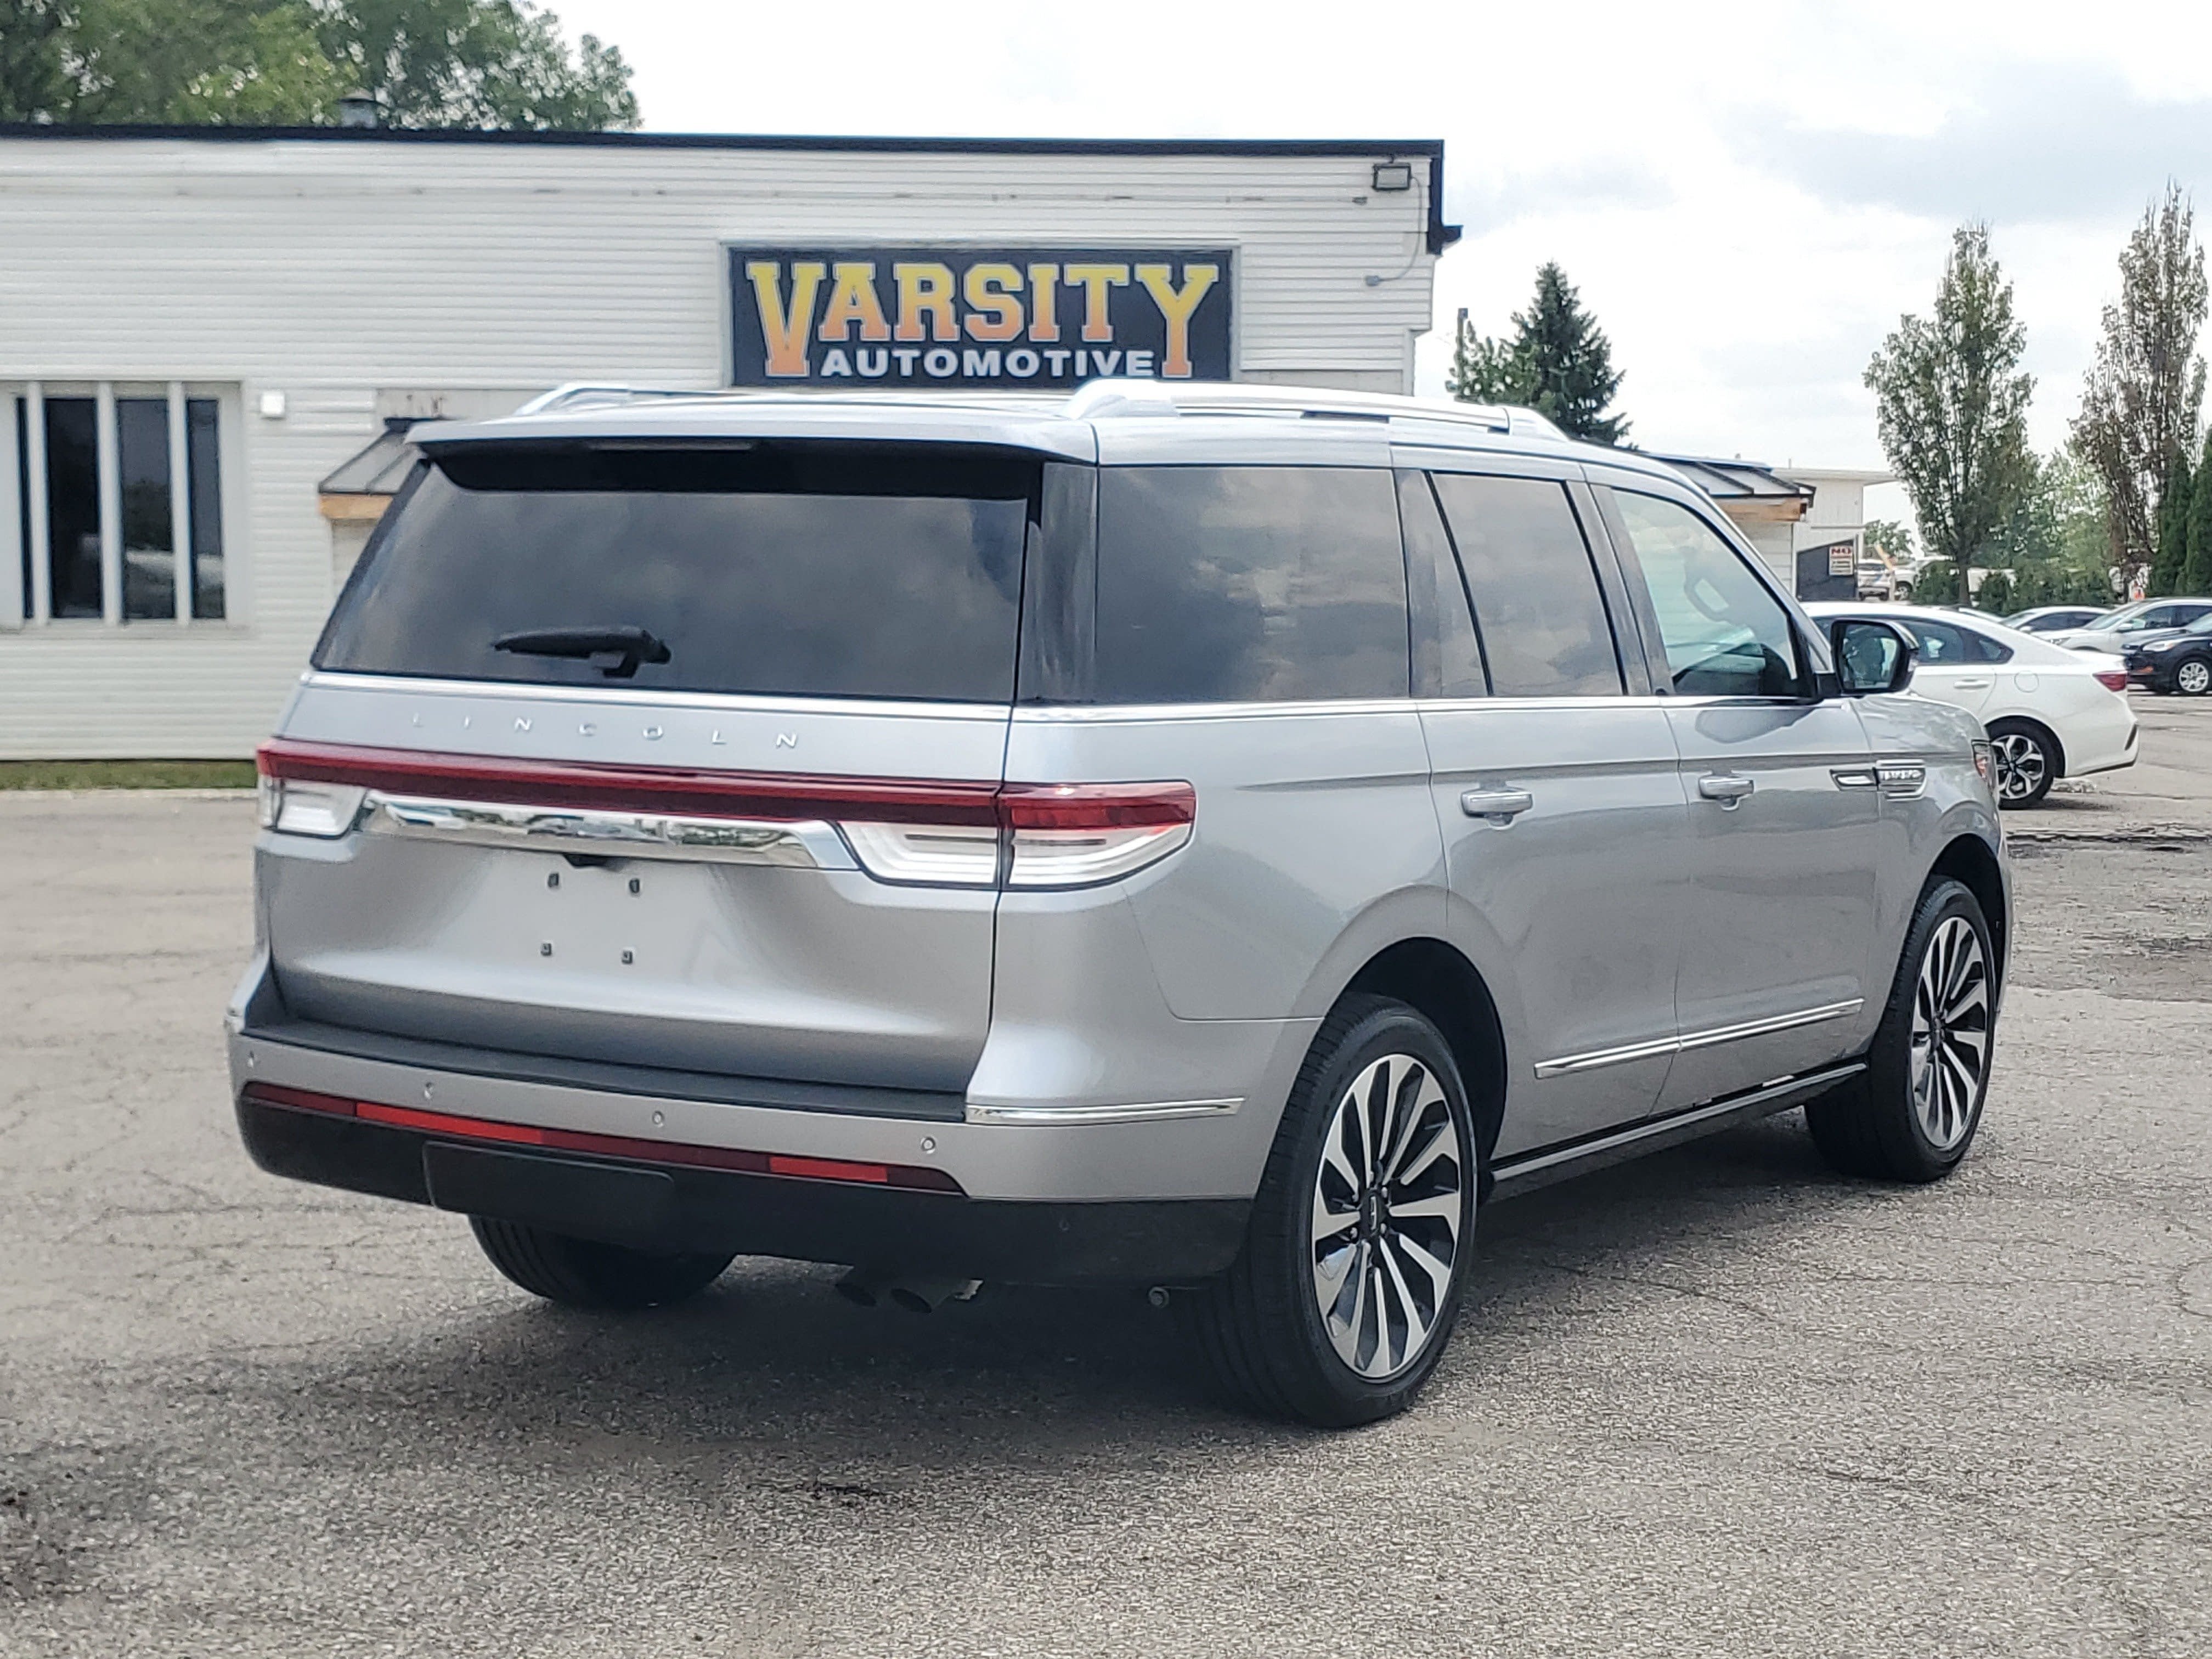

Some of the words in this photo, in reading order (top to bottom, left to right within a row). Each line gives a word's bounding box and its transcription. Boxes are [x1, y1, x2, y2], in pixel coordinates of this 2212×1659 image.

[746, 262, 1219, 378] VARSITY
[821, 349, 1154, 377] AUTOMOTIVE
[412, 713, 798, 749] LINCOLN
